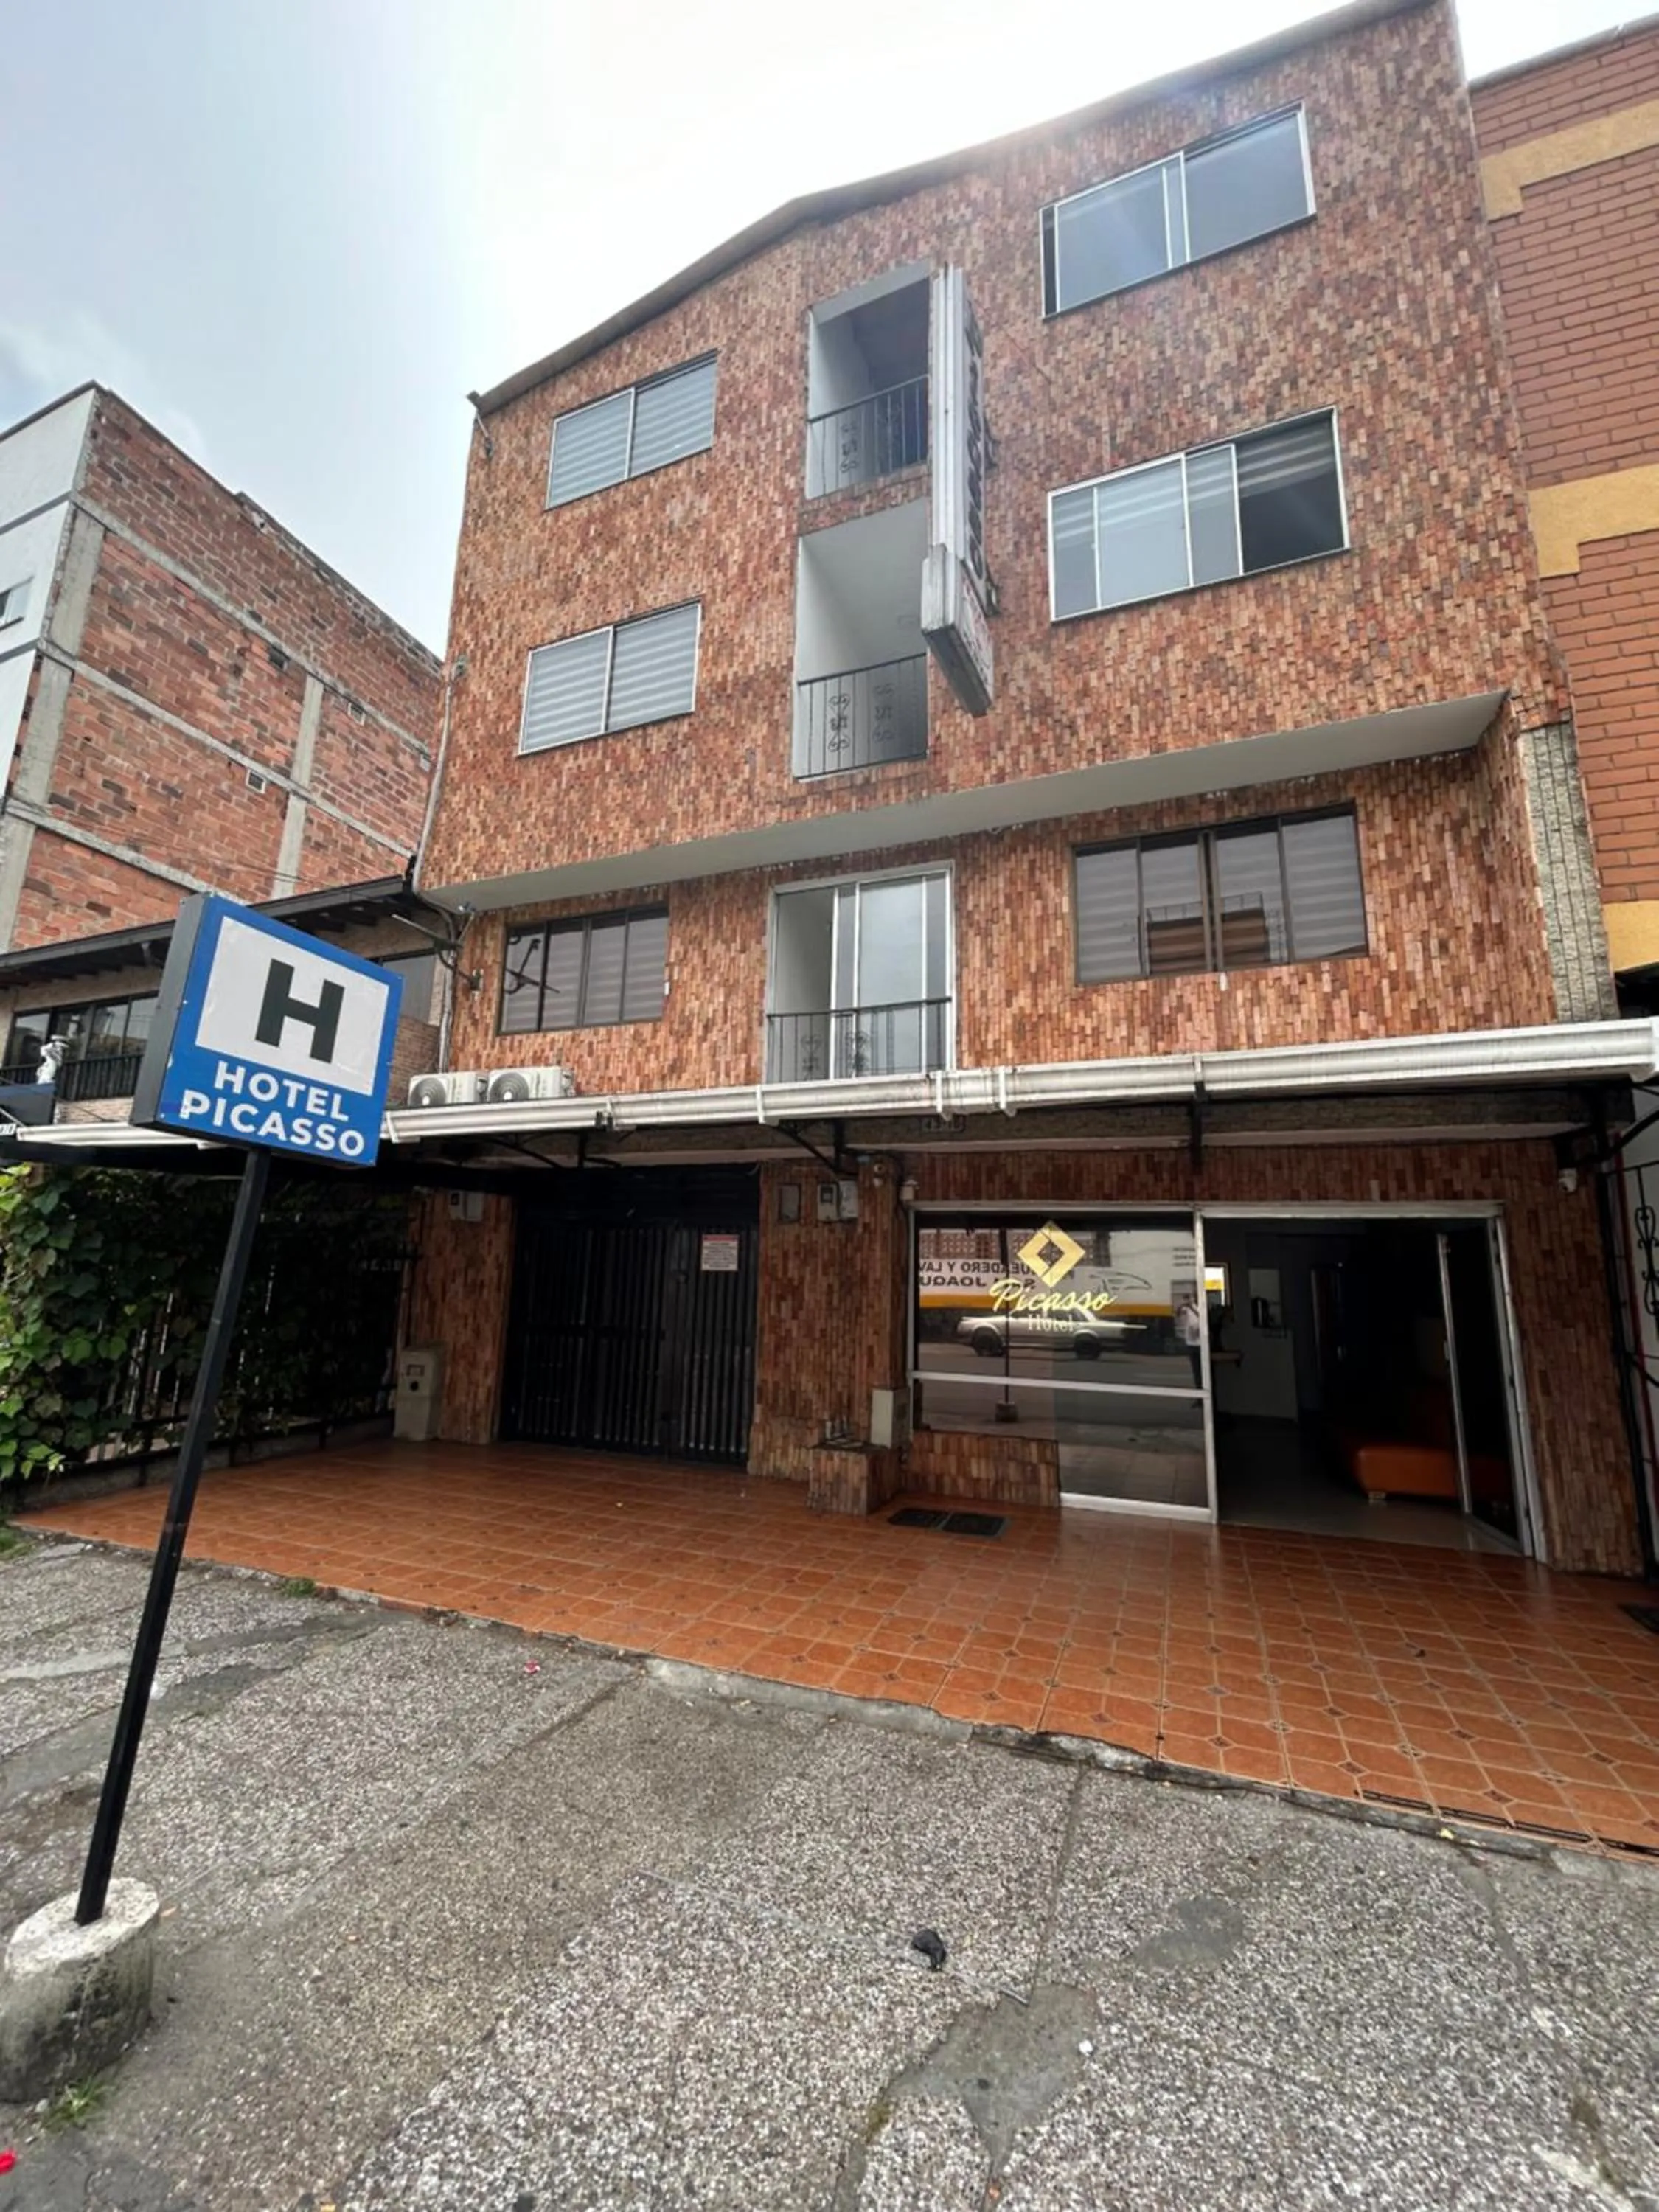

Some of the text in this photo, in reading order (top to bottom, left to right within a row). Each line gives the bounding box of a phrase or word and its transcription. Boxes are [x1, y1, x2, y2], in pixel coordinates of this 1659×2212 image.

[255, 958, 345, 1064] H
[214, 1061, 349, 1122] HOTEL
[178, 1089, 364, 1156] PICASSO
[989, 1279, 1119, 1313] Picasso
[1028, 1313, 1074, 1332] Hotel
